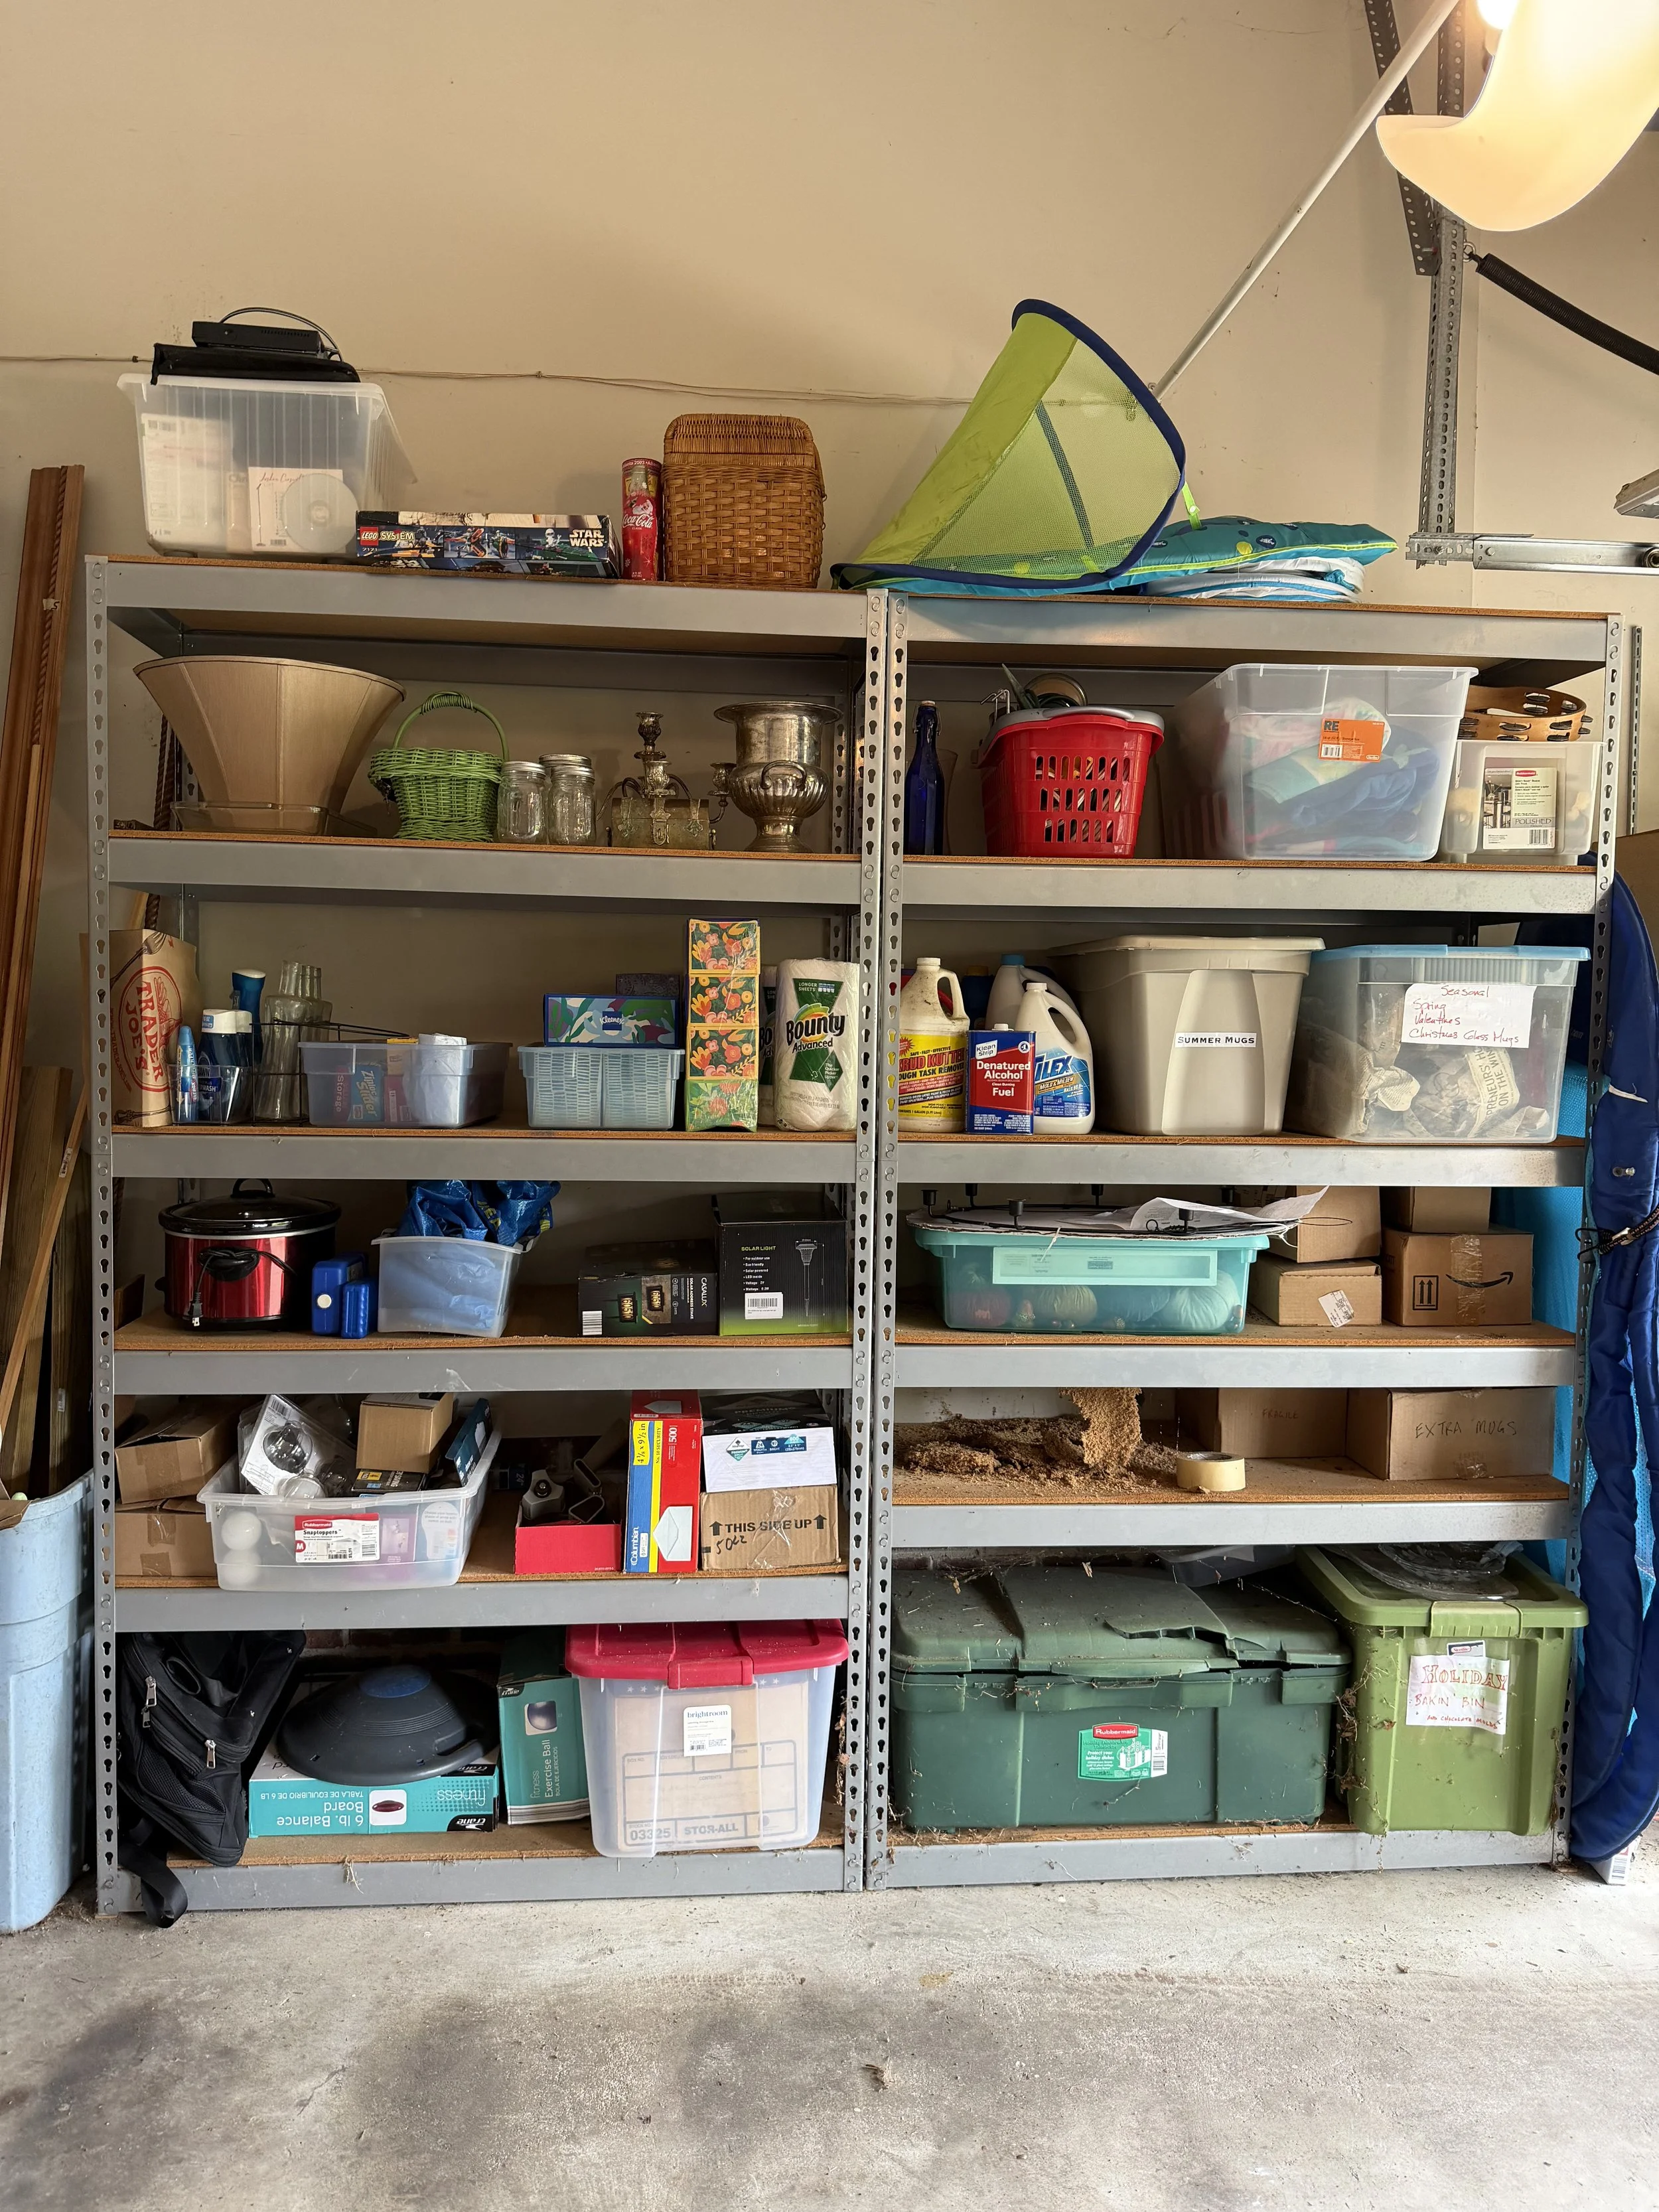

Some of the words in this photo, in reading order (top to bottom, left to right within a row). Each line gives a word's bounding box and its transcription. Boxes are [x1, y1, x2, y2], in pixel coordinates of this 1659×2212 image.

[622, 514, 655, 528] Coca-Cola
[380, 531, 415, 541] SYSTEM
[569, 530, 604, 538] STAR
[569, 538, 605, 548] WARS
[1441, 985, 1489, 997] Seasonal
[1413, 998, 1447, 1018] Spring
[600, 1014, 624, 1025] Kleenex
[1415, 1011, 1461, 1025] Valentines
[125, 1000, 149, 1071] JOE'S
[137, 981, 163, 1082] TRADER
[786, 1012, 845, 1046] Bounty
[1409, 1026, 1458, 1039] Christmas
[1494, 1027, 1519, 1047] Mugs
[792, 1037, 833, 1053] Advanced
[919, 1068, 936, 1077] TASK
[976, 1061, 1031, 1070] Denatured
[984, 1070, 1023, 1080] Alcohol
[1494, 1069, 1507, 1090] THE
[361, 1070, 377, 1097] Ziploc
[1039, 1082, 1052, 1090] MOLD
[1057, 1076, 1075, 1086] MILDEW
[993, 1087, 1015, 1096] Fuel
[356, 1081, 378, 1117] Slider
[1498, 1092, 1509, 1106] ON
[1262, 1408, 1299, 1420] FRAGILE
[668, 1427, 677, 1443] 500
[1415, 1422, 1461, 1439] EXTRA
[1476, 1420, 1517, 1436] MUGS
[725, 1522, 756, 1533] THIS
[759, 1520, 792, 1531] SIDE
[794, 1518, 812, 1529] UP
[630, 1526, 639, 1564] Columbian
[1421, 1664, 1508, 1691] HOLIDAY
[1414, 1693, 1455, 1707] BAKIN'
[1462, 1696, 1485, 1709] BIN
[1476, 1718, 1498, 1730] MOLDS
[541, 1739, 551, 1757] Ball
[530, 1770, 540, 1799] fitness
[543, 1759, 553, 1798] Exercise
[436, 1789, 486, 1806] fitness
[323, 1801, 364, 1813] Board
[276, 1814, 330, 1826] Balance
[337, 1814, 350, 1825] lb.
[356, 1814, 363, 1825] 6
[630, 1828, 672, 1841] 03325
[684, 1823, 739, 1836] STOR-ALL
